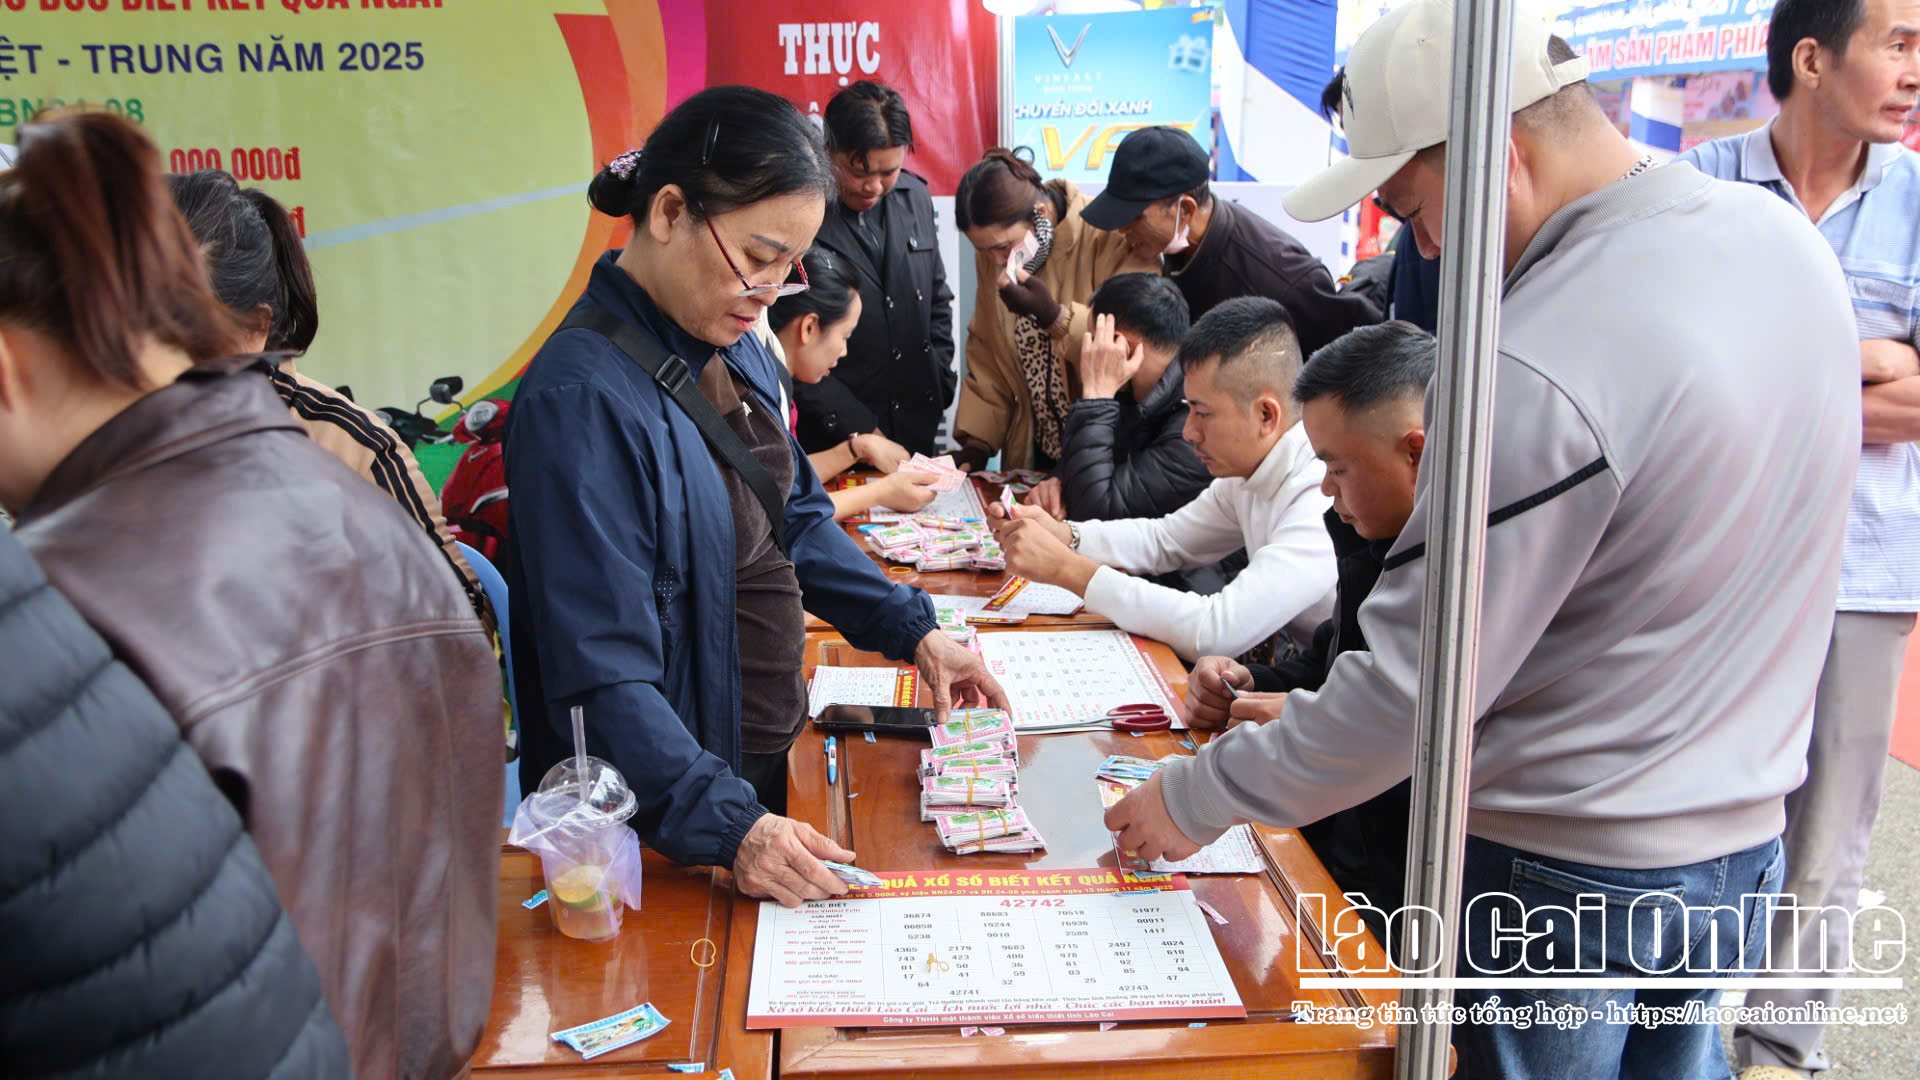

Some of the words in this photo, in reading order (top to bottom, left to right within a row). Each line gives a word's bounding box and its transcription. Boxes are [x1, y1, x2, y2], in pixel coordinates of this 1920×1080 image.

[82, 43, 224, 74] TRUNG
[239, 34, 324, 72] NĂM
[338, 42, 425, 71] 2025
[778, 21, 880, 87] THỰC
[1104, 99, 1153, 117] XANH
[923, 873, 953, 887] XỔ
[956, 873, 983, 887] SỐ
[988, 873, 1031, 887] BIẾT
[1037, 875, 1071, 888] KẾT
[1078, 872, 1119, 886] QUẢ
[1000, 899, 1065, 907] 42742
